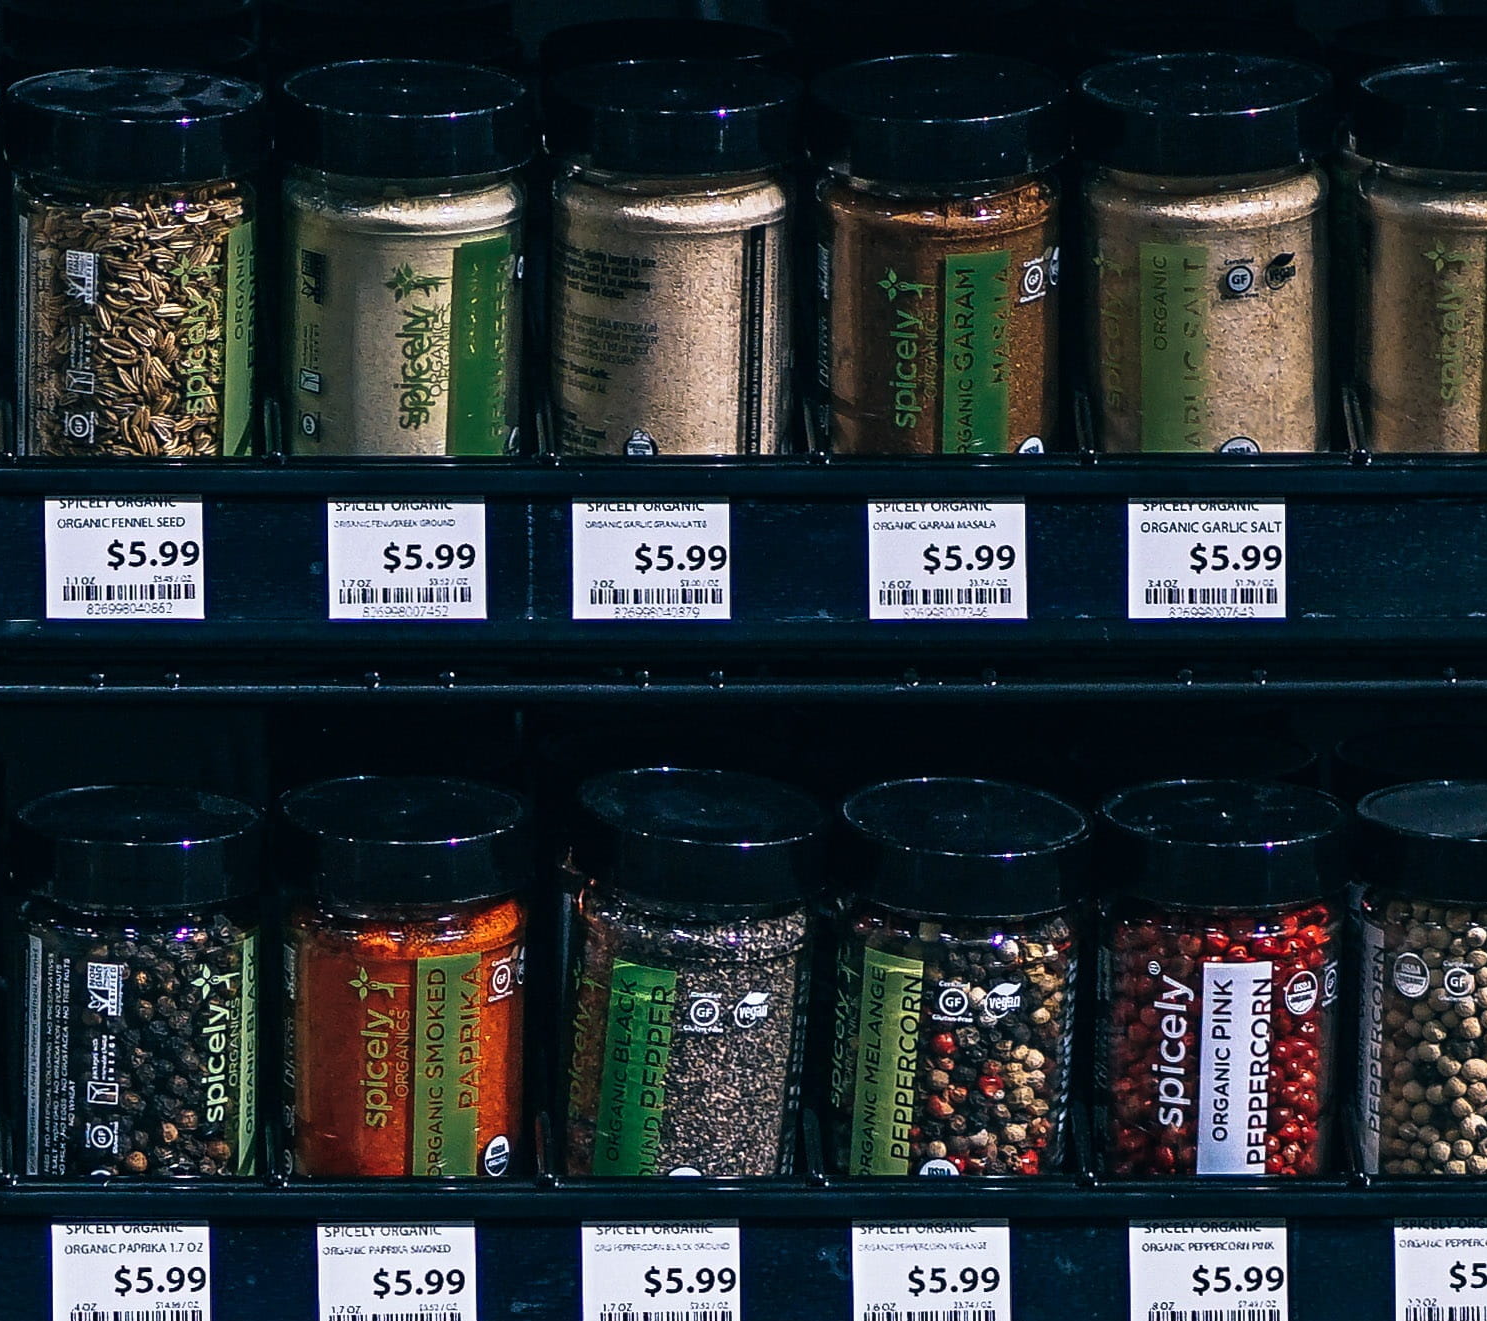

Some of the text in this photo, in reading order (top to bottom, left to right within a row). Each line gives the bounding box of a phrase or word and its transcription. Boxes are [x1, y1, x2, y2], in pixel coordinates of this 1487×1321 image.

[426, 965, 447, 1082] SMOKED
[457, 964, 485, 1110] PAPRIKA
[1157, 974, 1195, 1129] spicely
[1212, 978, 1232, 1143] ORGANIC PINK
[1246, 977, 1272, 1165] PEPPERCORN
[909, 1266, 1000, 1296] $5.99
